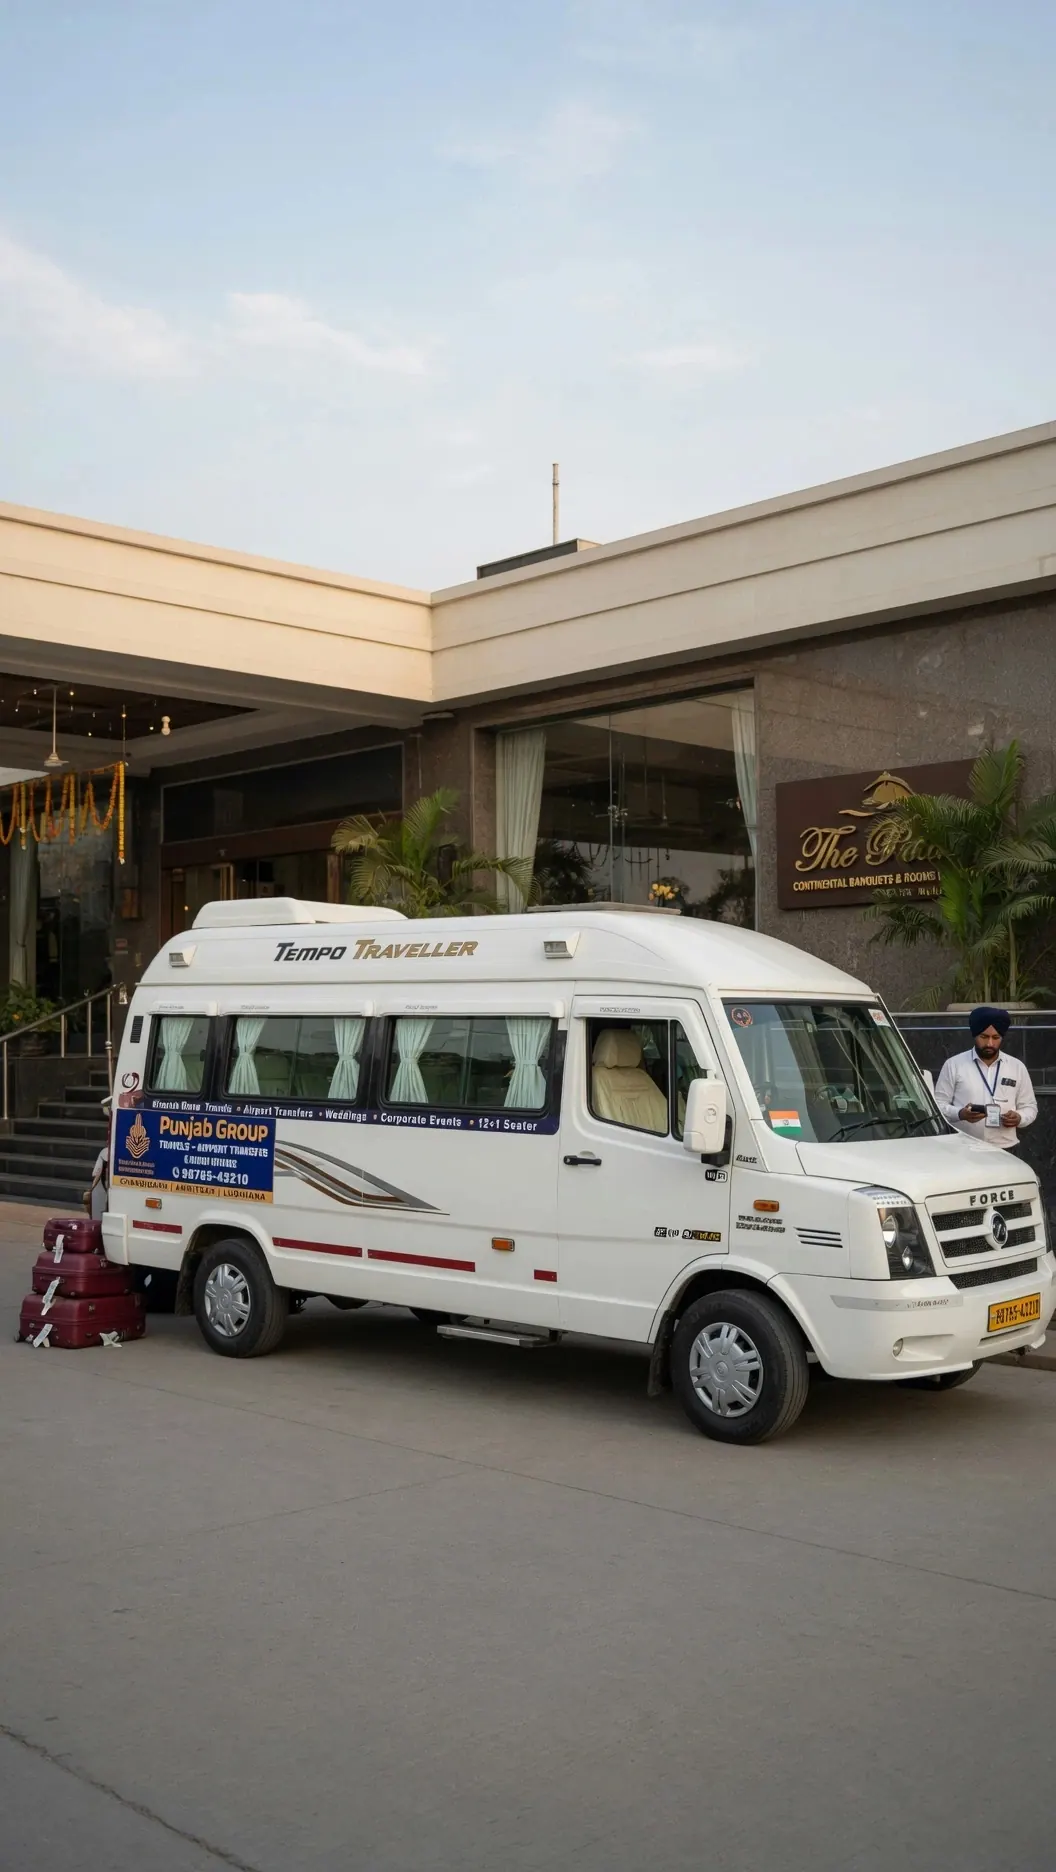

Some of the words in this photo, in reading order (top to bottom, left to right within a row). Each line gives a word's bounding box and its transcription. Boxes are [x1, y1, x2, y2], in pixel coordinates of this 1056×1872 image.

[795, 825, 859, 872] The
[380, 1112, 427, 1125] Corporate
[969, 1189, 1015, 1206] FORCE
